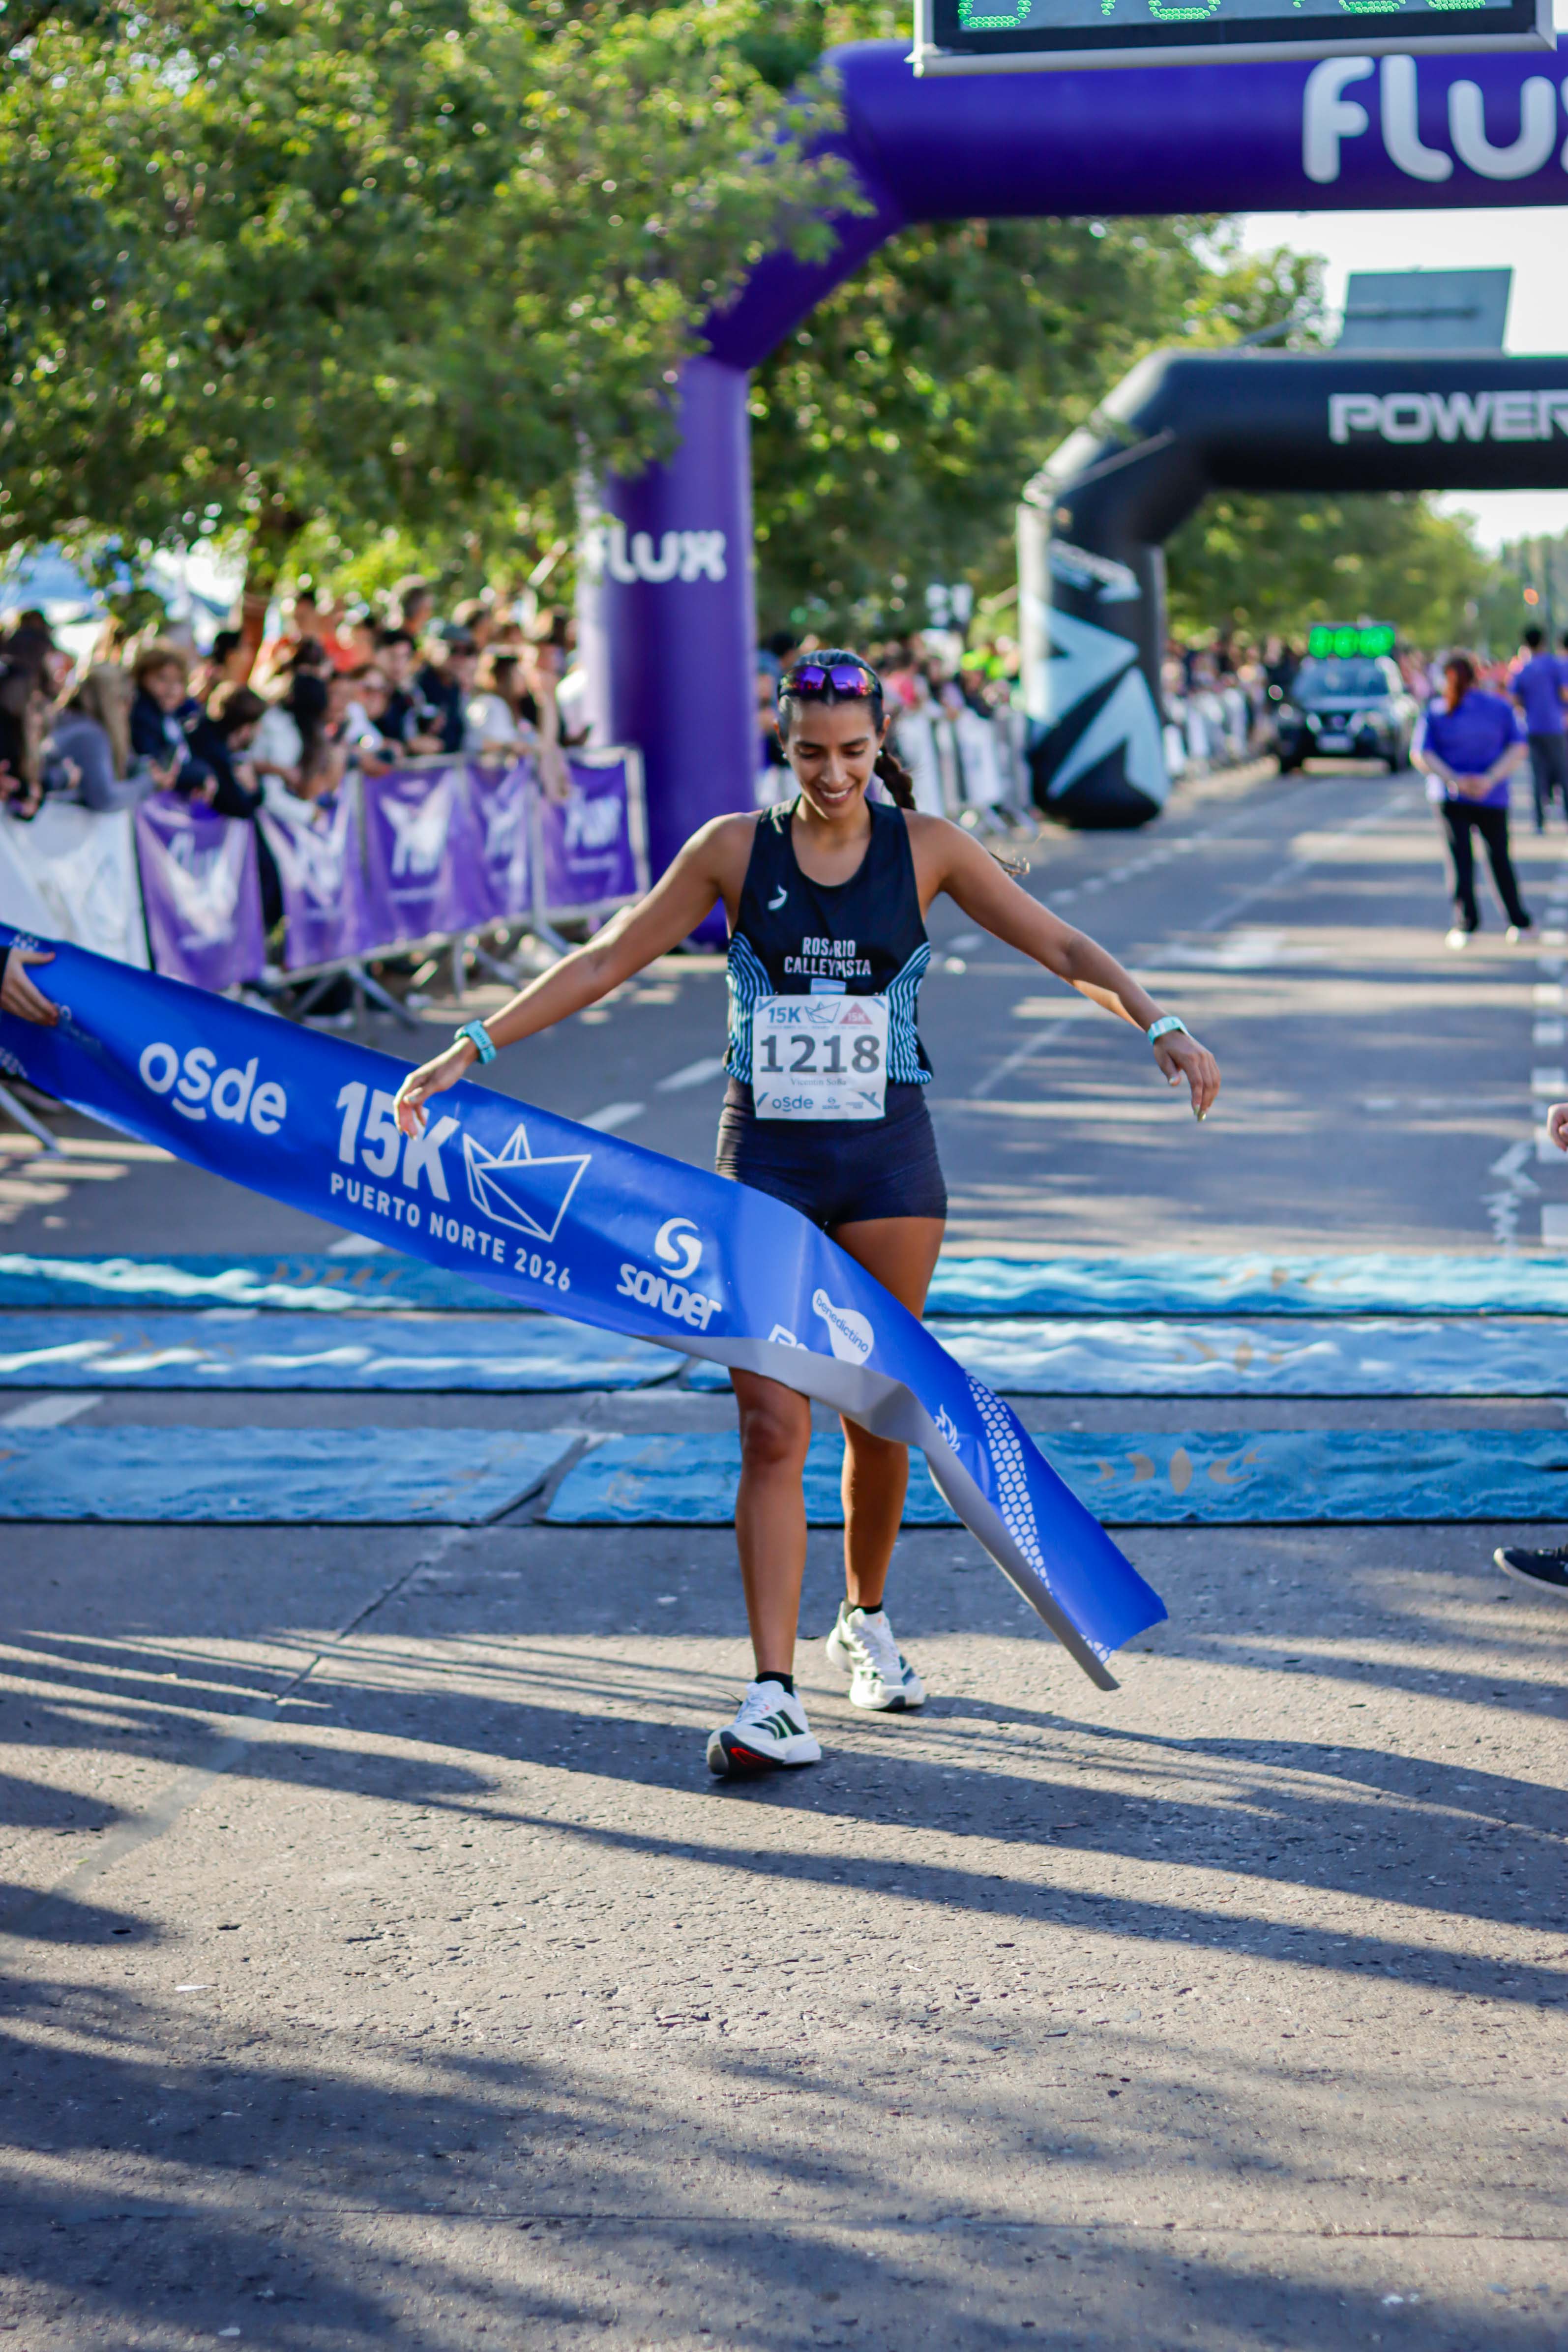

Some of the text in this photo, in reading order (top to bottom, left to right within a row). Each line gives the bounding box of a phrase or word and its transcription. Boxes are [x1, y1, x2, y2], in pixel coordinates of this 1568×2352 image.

[1302, 54, 1568, 183] flu
[768, 1006, 801, 1023] 15K
[139, 1042, 287, 1135] osde
[760, 1034, 880, 1074] 1218
[772, 1094, 814, 1110] osde
[336, 1081, 461, 1203] 15K
[330, 1172, 571, 1292] PUERTO NORTE 2026
[817, 1294, 869, 1352] benedictino
